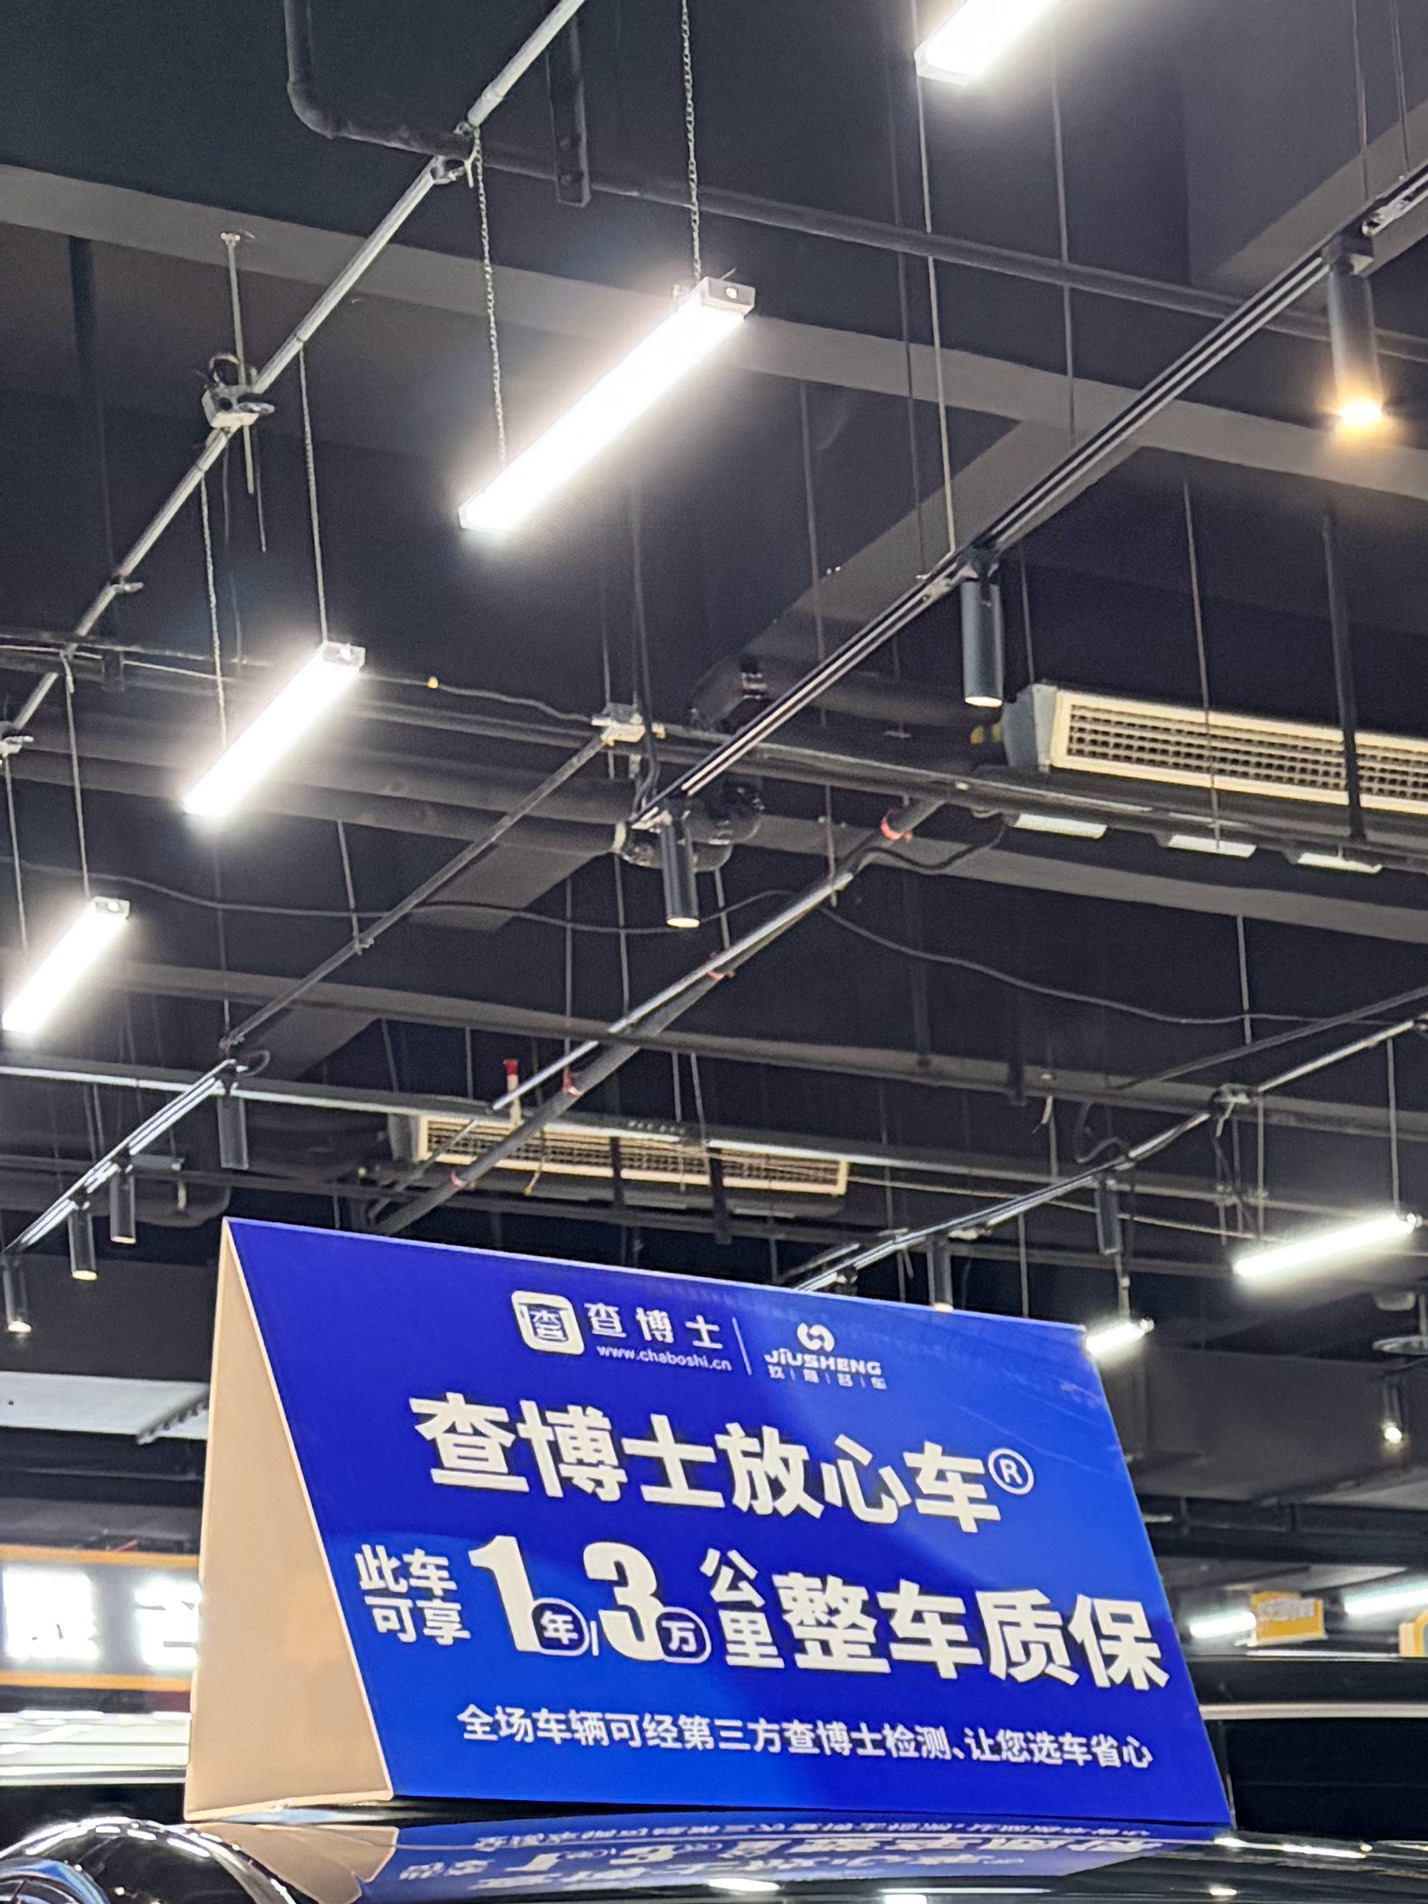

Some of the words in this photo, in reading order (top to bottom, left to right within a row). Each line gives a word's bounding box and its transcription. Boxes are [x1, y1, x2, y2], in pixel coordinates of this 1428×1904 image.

[583, 1301, 724, 1351] 查博士
[596, 1343, 733, 1372] www.chaboshi.cn
